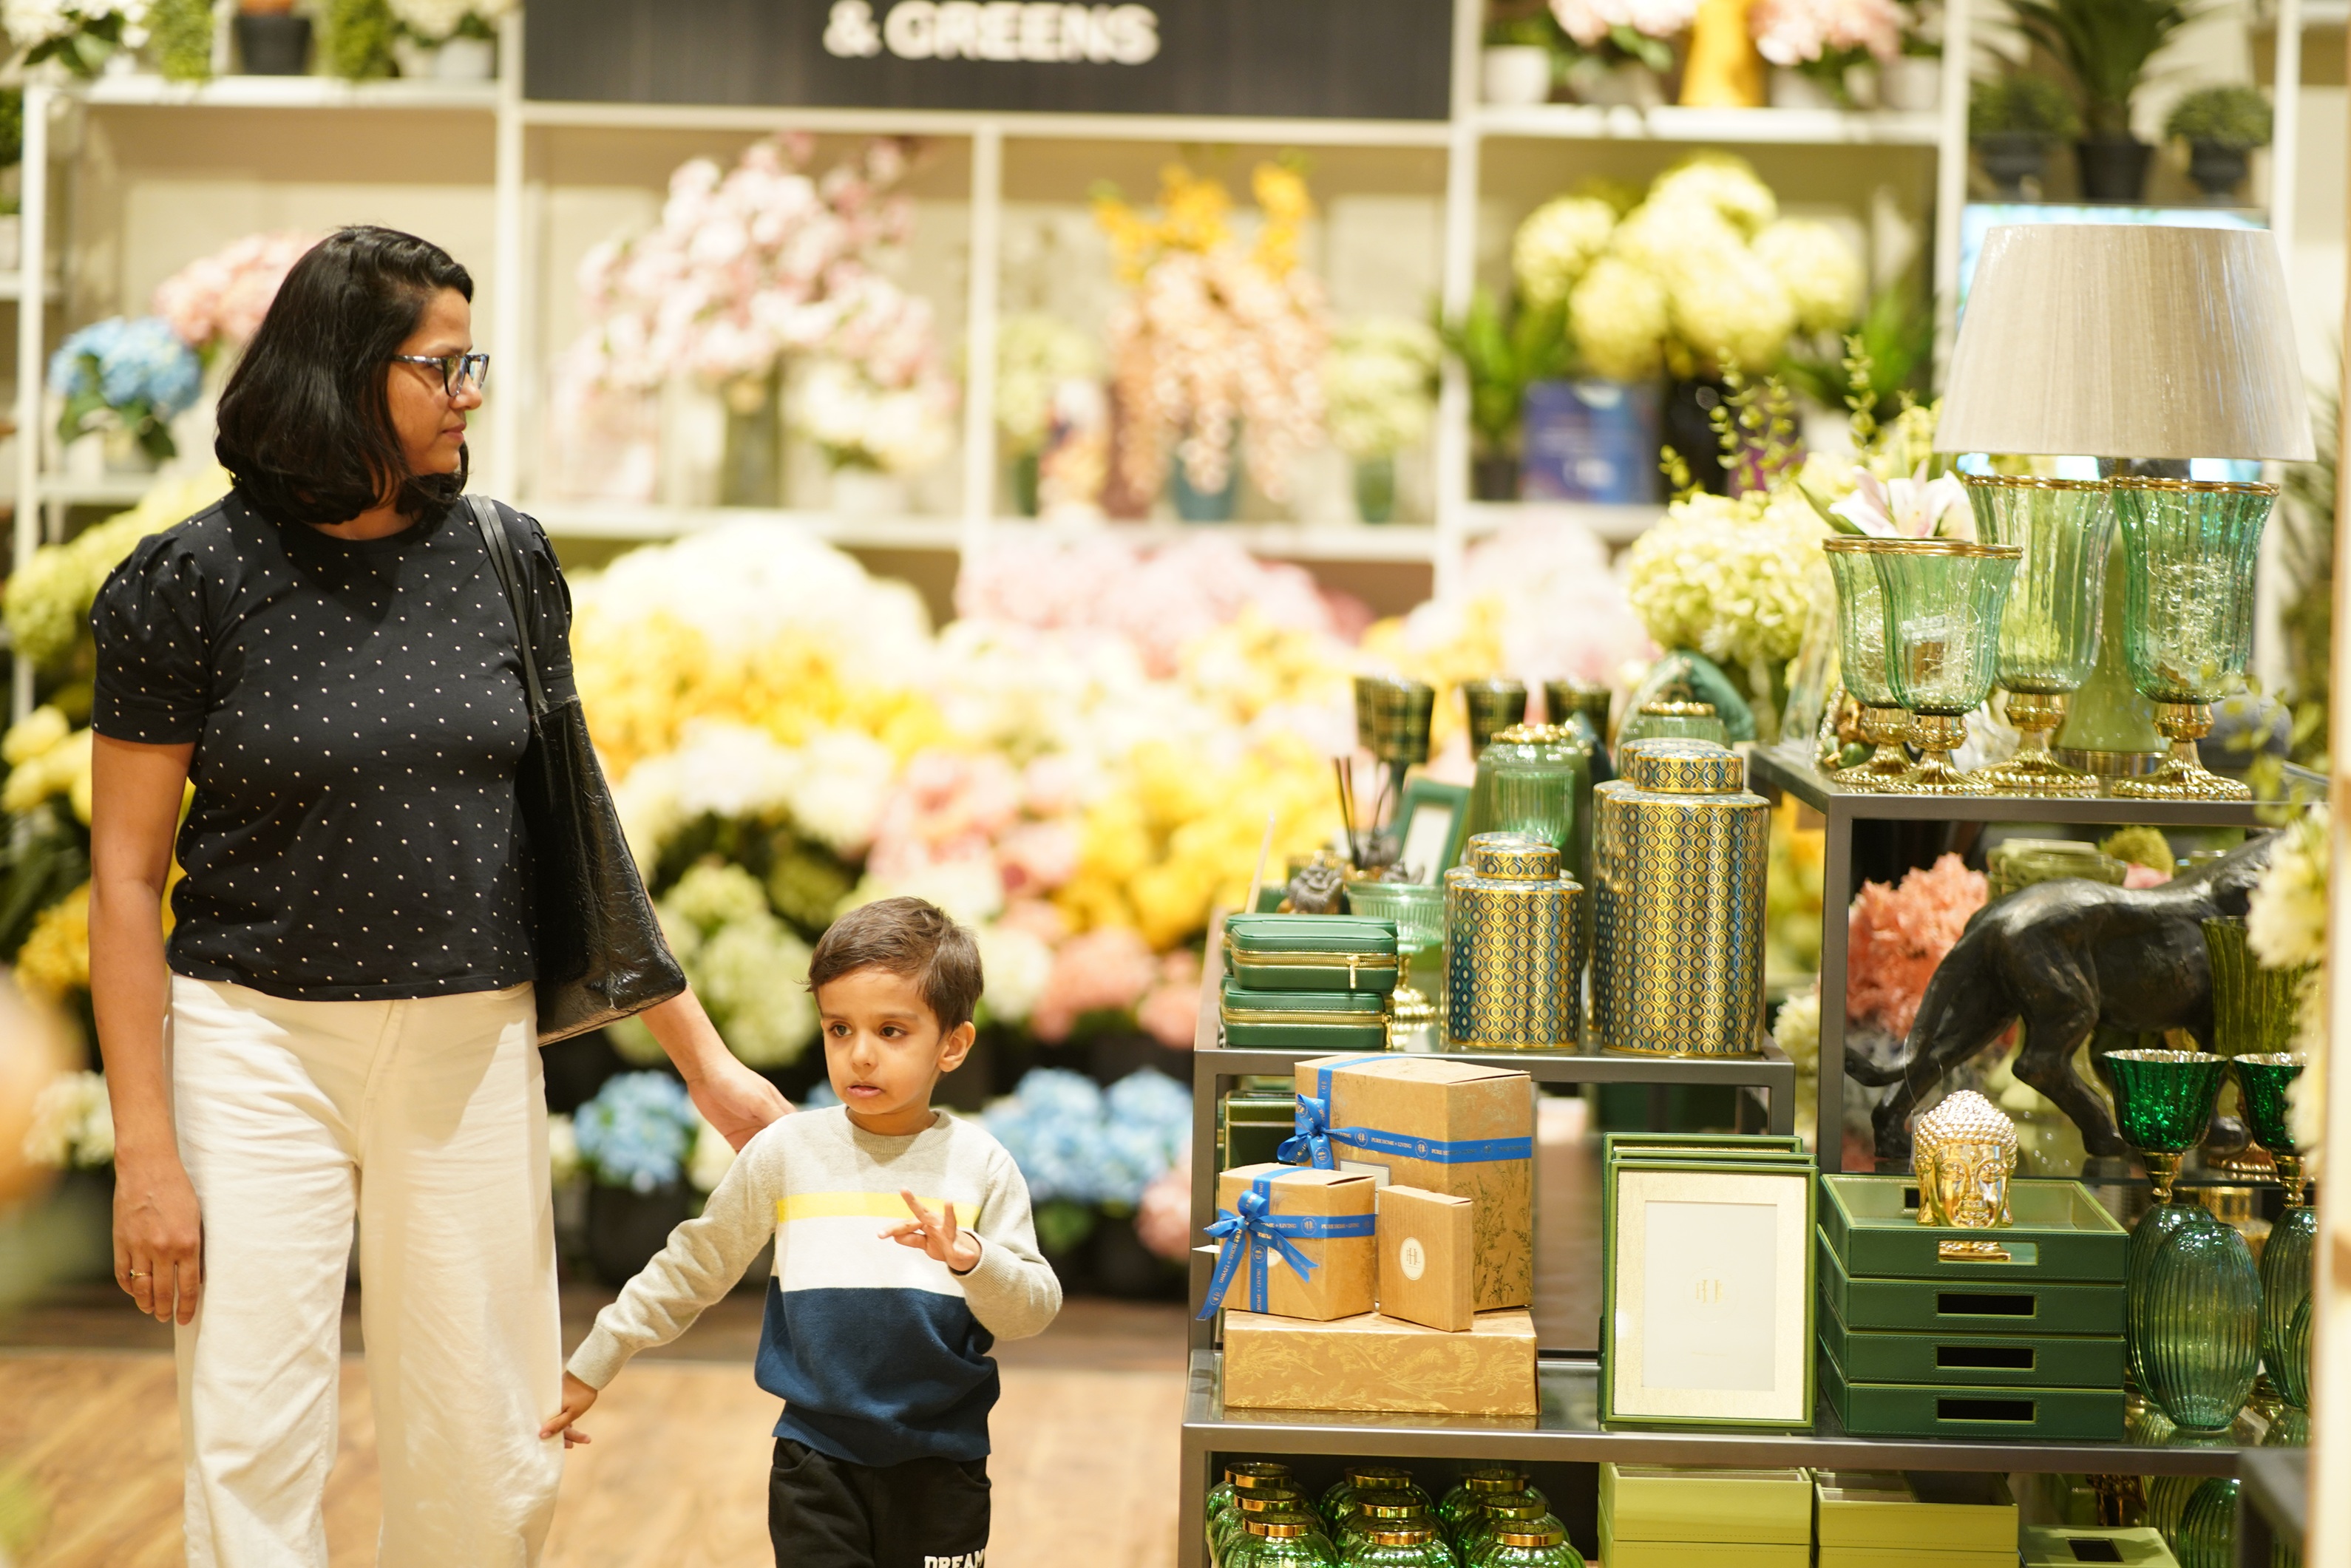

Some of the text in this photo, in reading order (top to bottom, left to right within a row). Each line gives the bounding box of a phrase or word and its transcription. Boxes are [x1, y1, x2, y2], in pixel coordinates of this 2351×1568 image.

[823, 0, 1161, 65] & GREENS
[1218, 1264, 1230, 1283] LIVING
